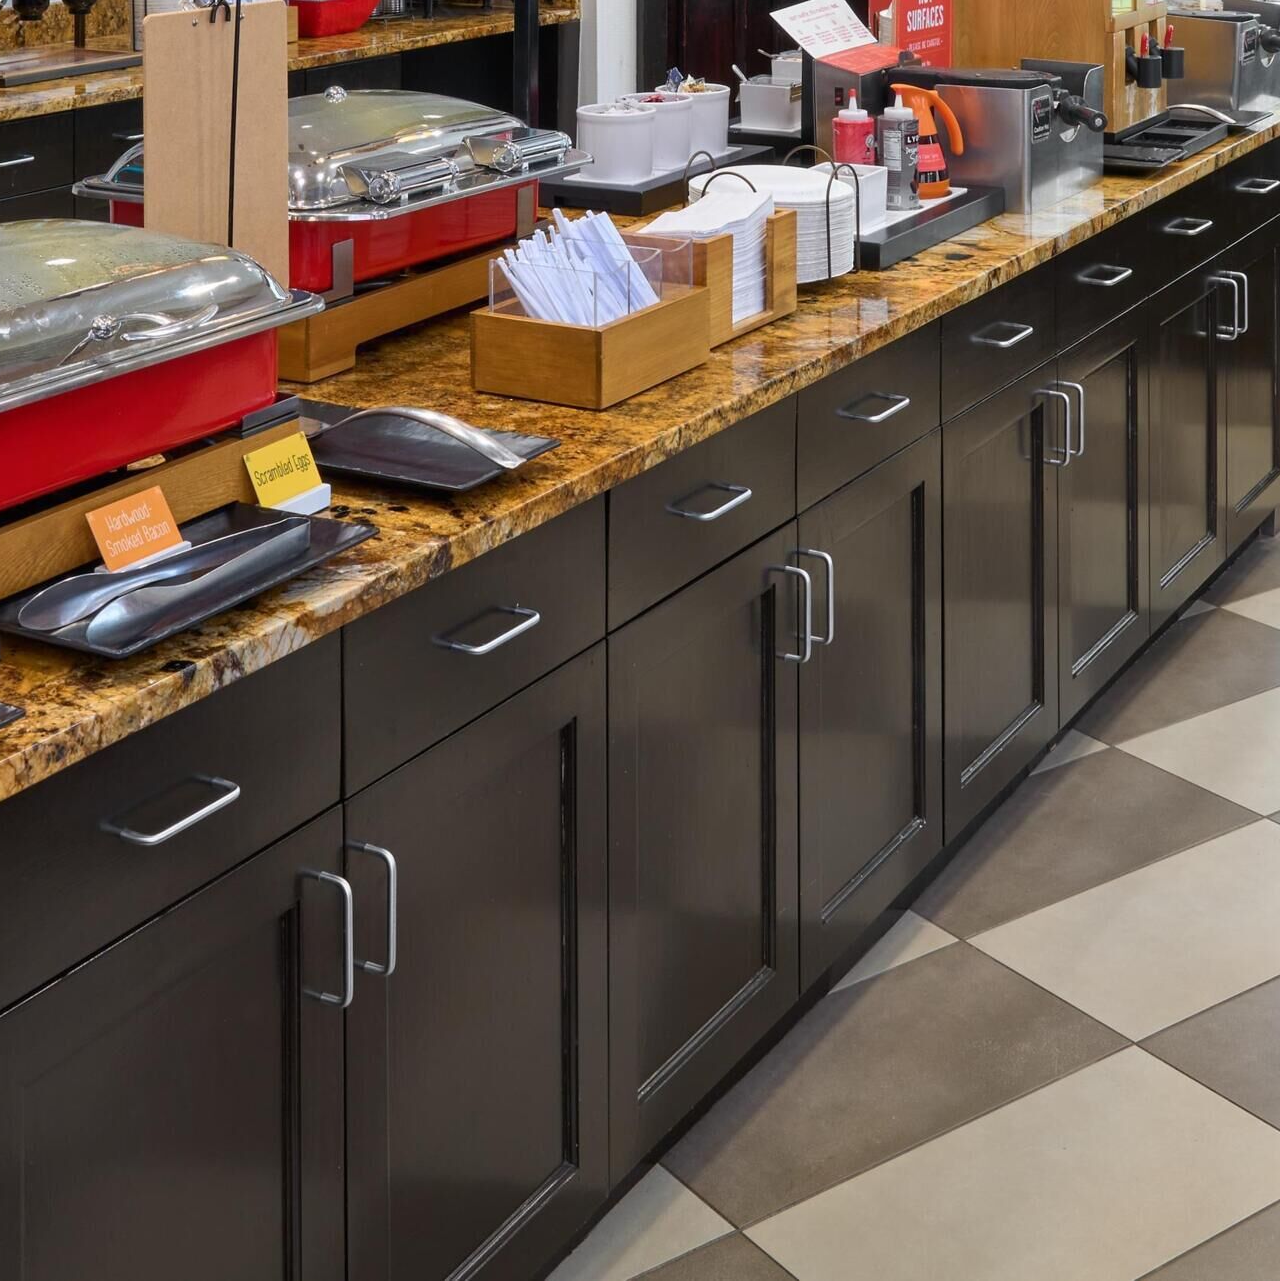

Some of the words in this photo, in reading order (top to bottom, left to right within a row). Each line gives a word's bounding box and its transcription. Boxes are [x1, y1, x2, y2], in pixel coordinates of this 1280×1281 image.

[906, 5, 944, 32] SURFACES
[254, 457, 294, 487] Scrambled
[291, 453, 311, 473] Eggs
[104, 503, 152, 533] Hardwood-
[105, 529, 145, 557] Smoked
[141, 521, 171, 542] Bacon
